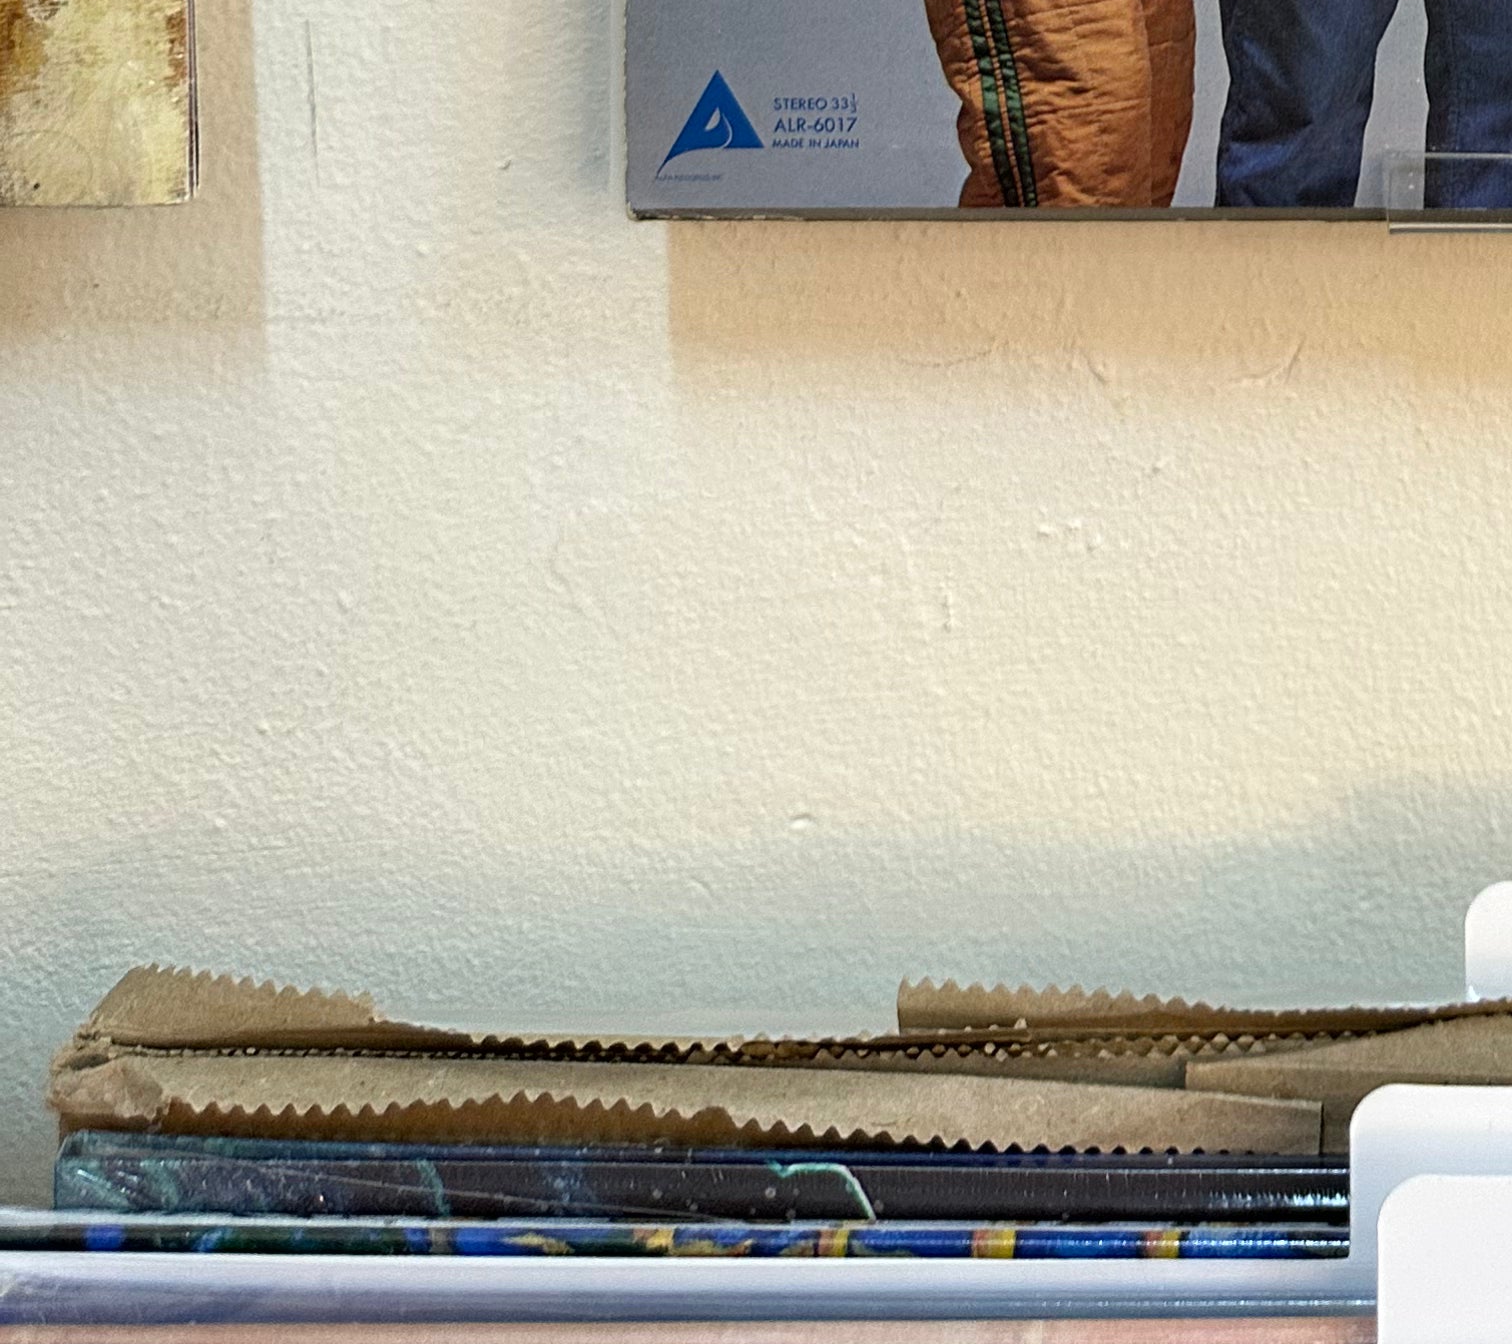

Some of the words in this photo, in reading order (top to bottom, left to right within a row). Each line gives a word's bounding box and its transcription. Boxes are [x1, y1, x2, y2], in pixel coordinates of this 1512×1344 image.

[774, 97, 828, 110] STEREO
[774, 117, 857, 133] ALR-6017
[772, 139, 804, 148] MADE
[809, 139, 821, 148] IN
[824, 139, 859, 149] JAPAN
